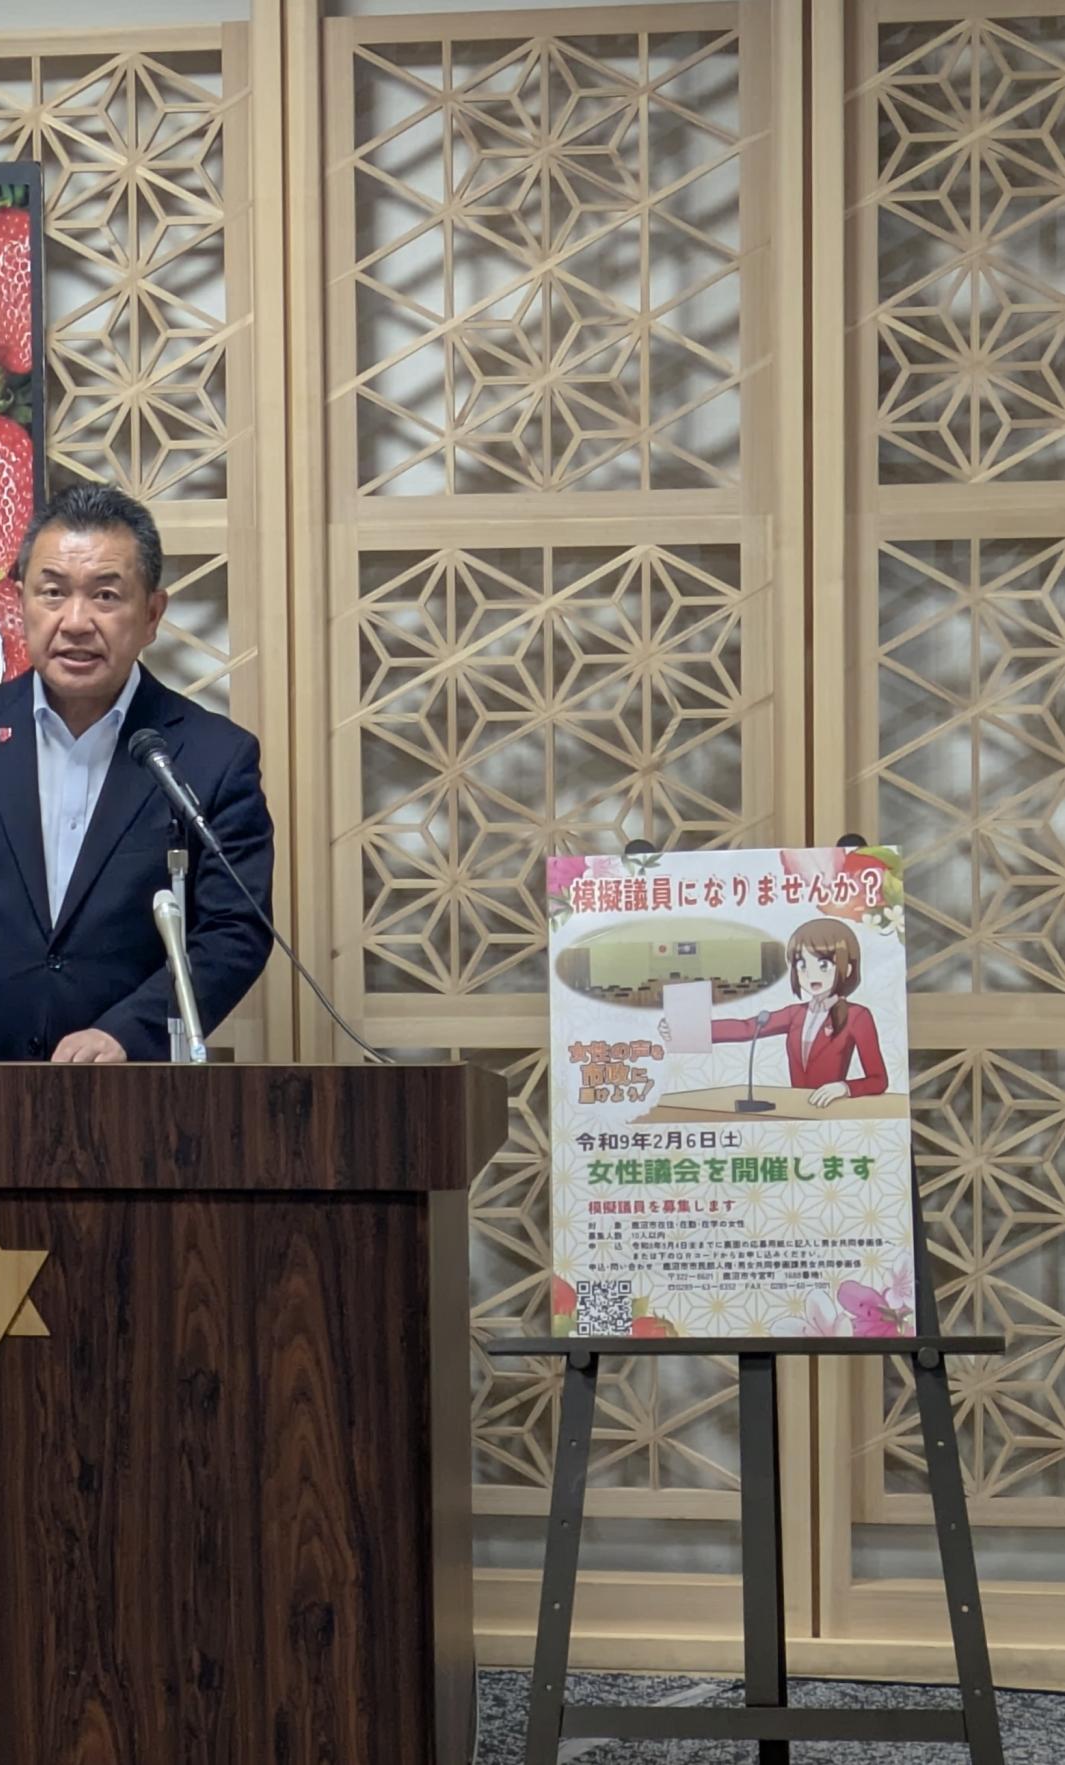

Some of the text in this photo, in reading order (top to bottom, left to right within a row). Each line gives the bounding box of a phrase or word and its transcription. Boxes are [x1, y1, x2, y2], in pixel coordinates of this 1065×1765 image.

[586, 1155, 875, 1186] 女性議会を開催します
